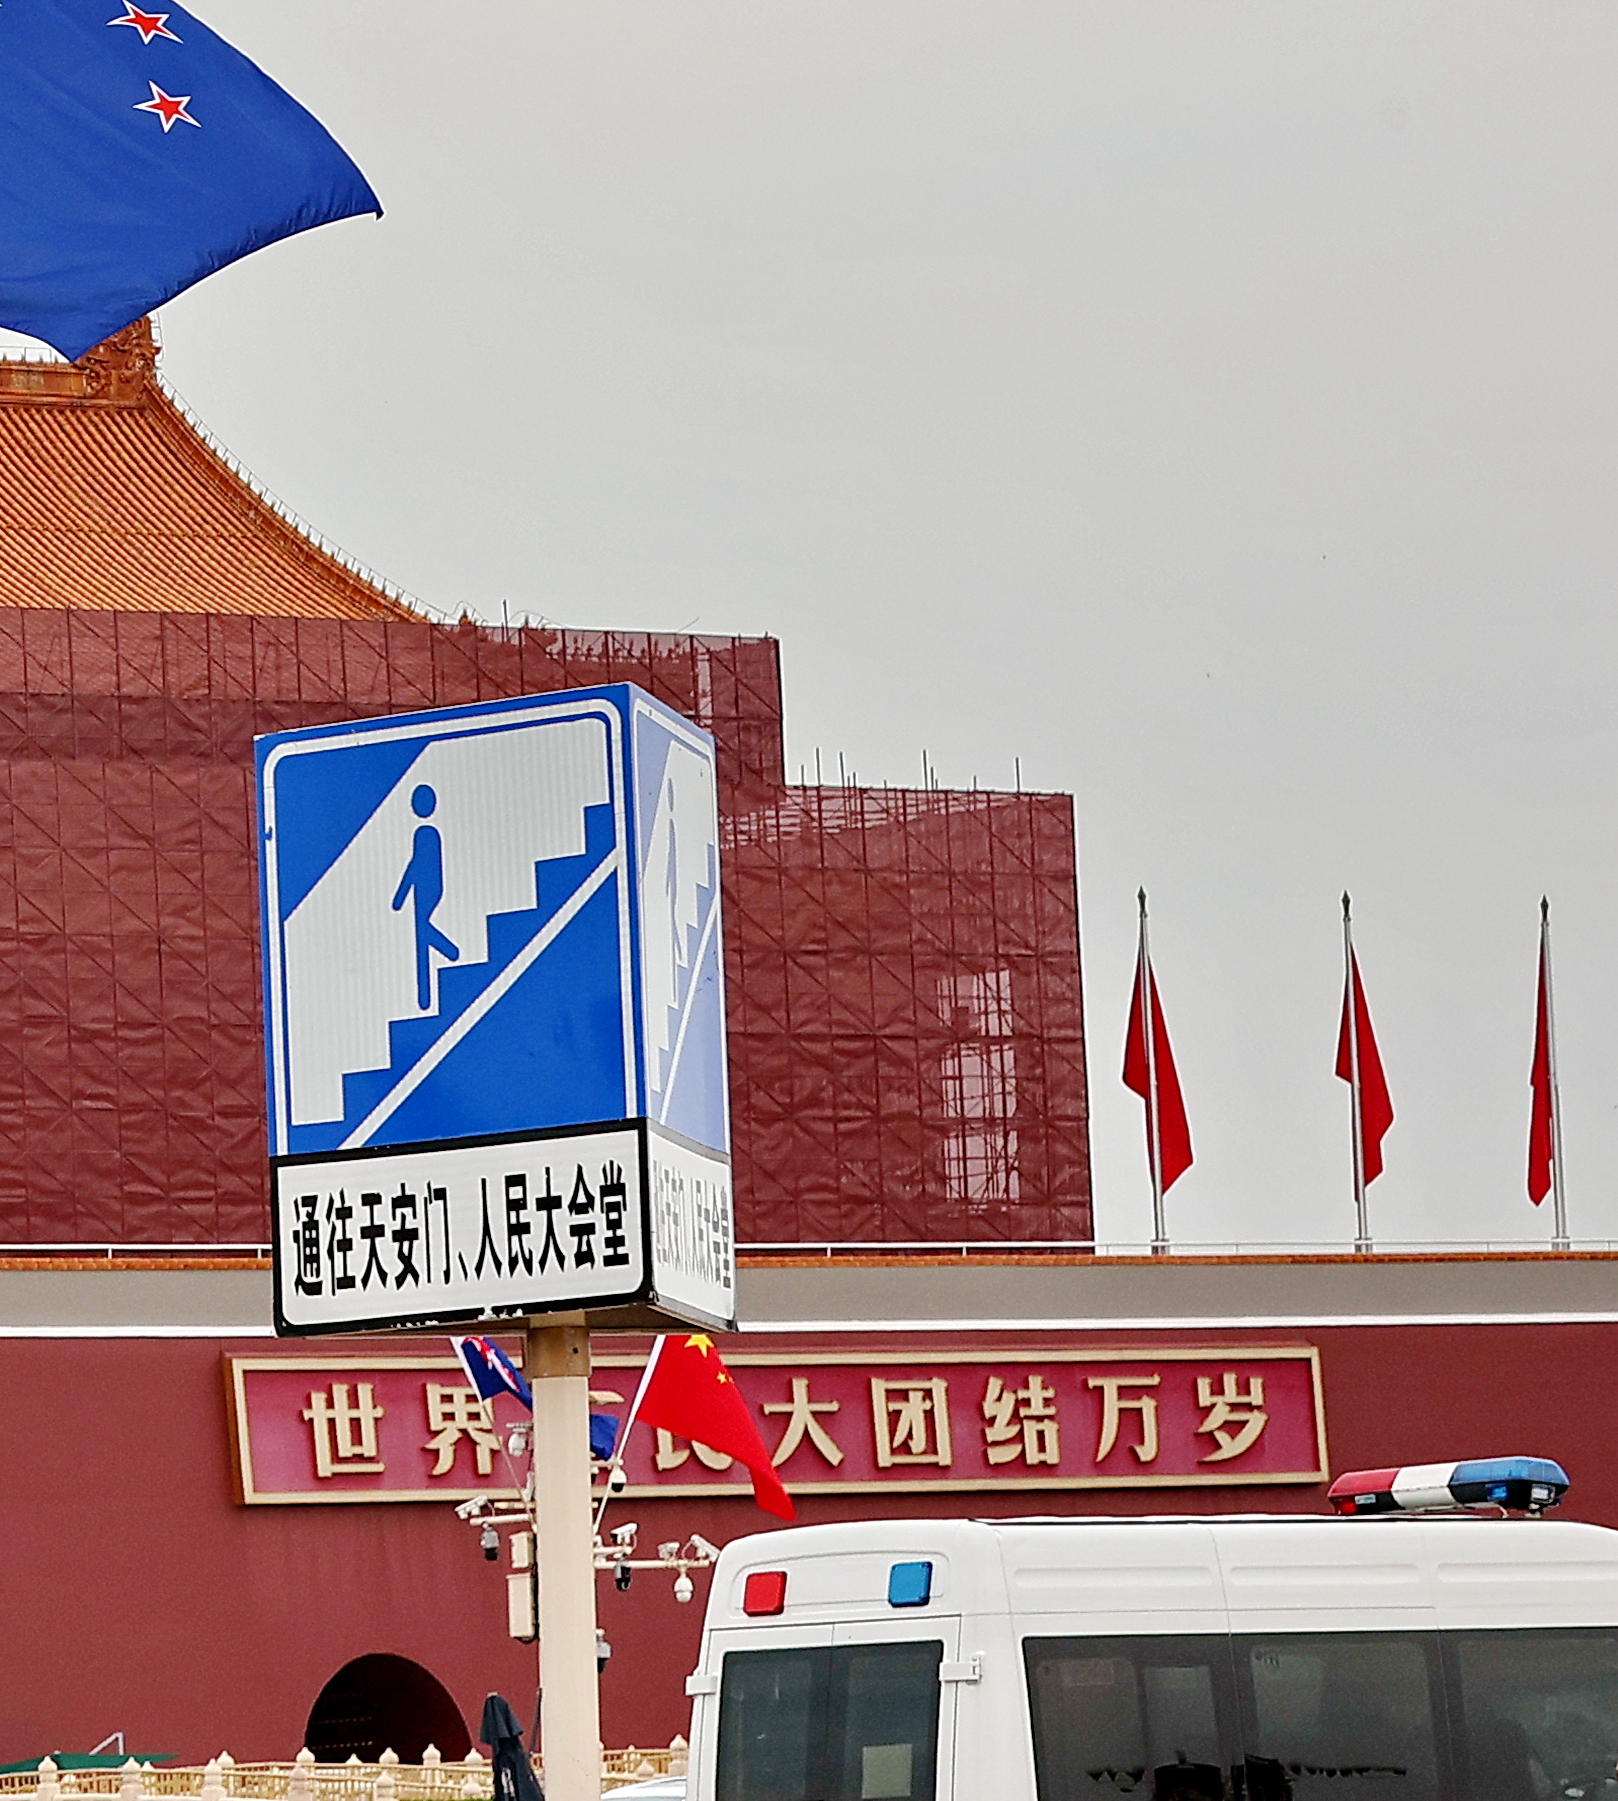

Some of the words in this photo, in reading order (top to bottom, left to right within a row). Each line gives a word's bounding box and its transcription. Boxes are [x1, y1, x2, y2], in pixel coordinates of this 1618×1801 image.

[293, 1161, 630, 1297] 通往天安门、人民大会堂
[303, 1373, 1268, 1477] 世界大团结万岁
